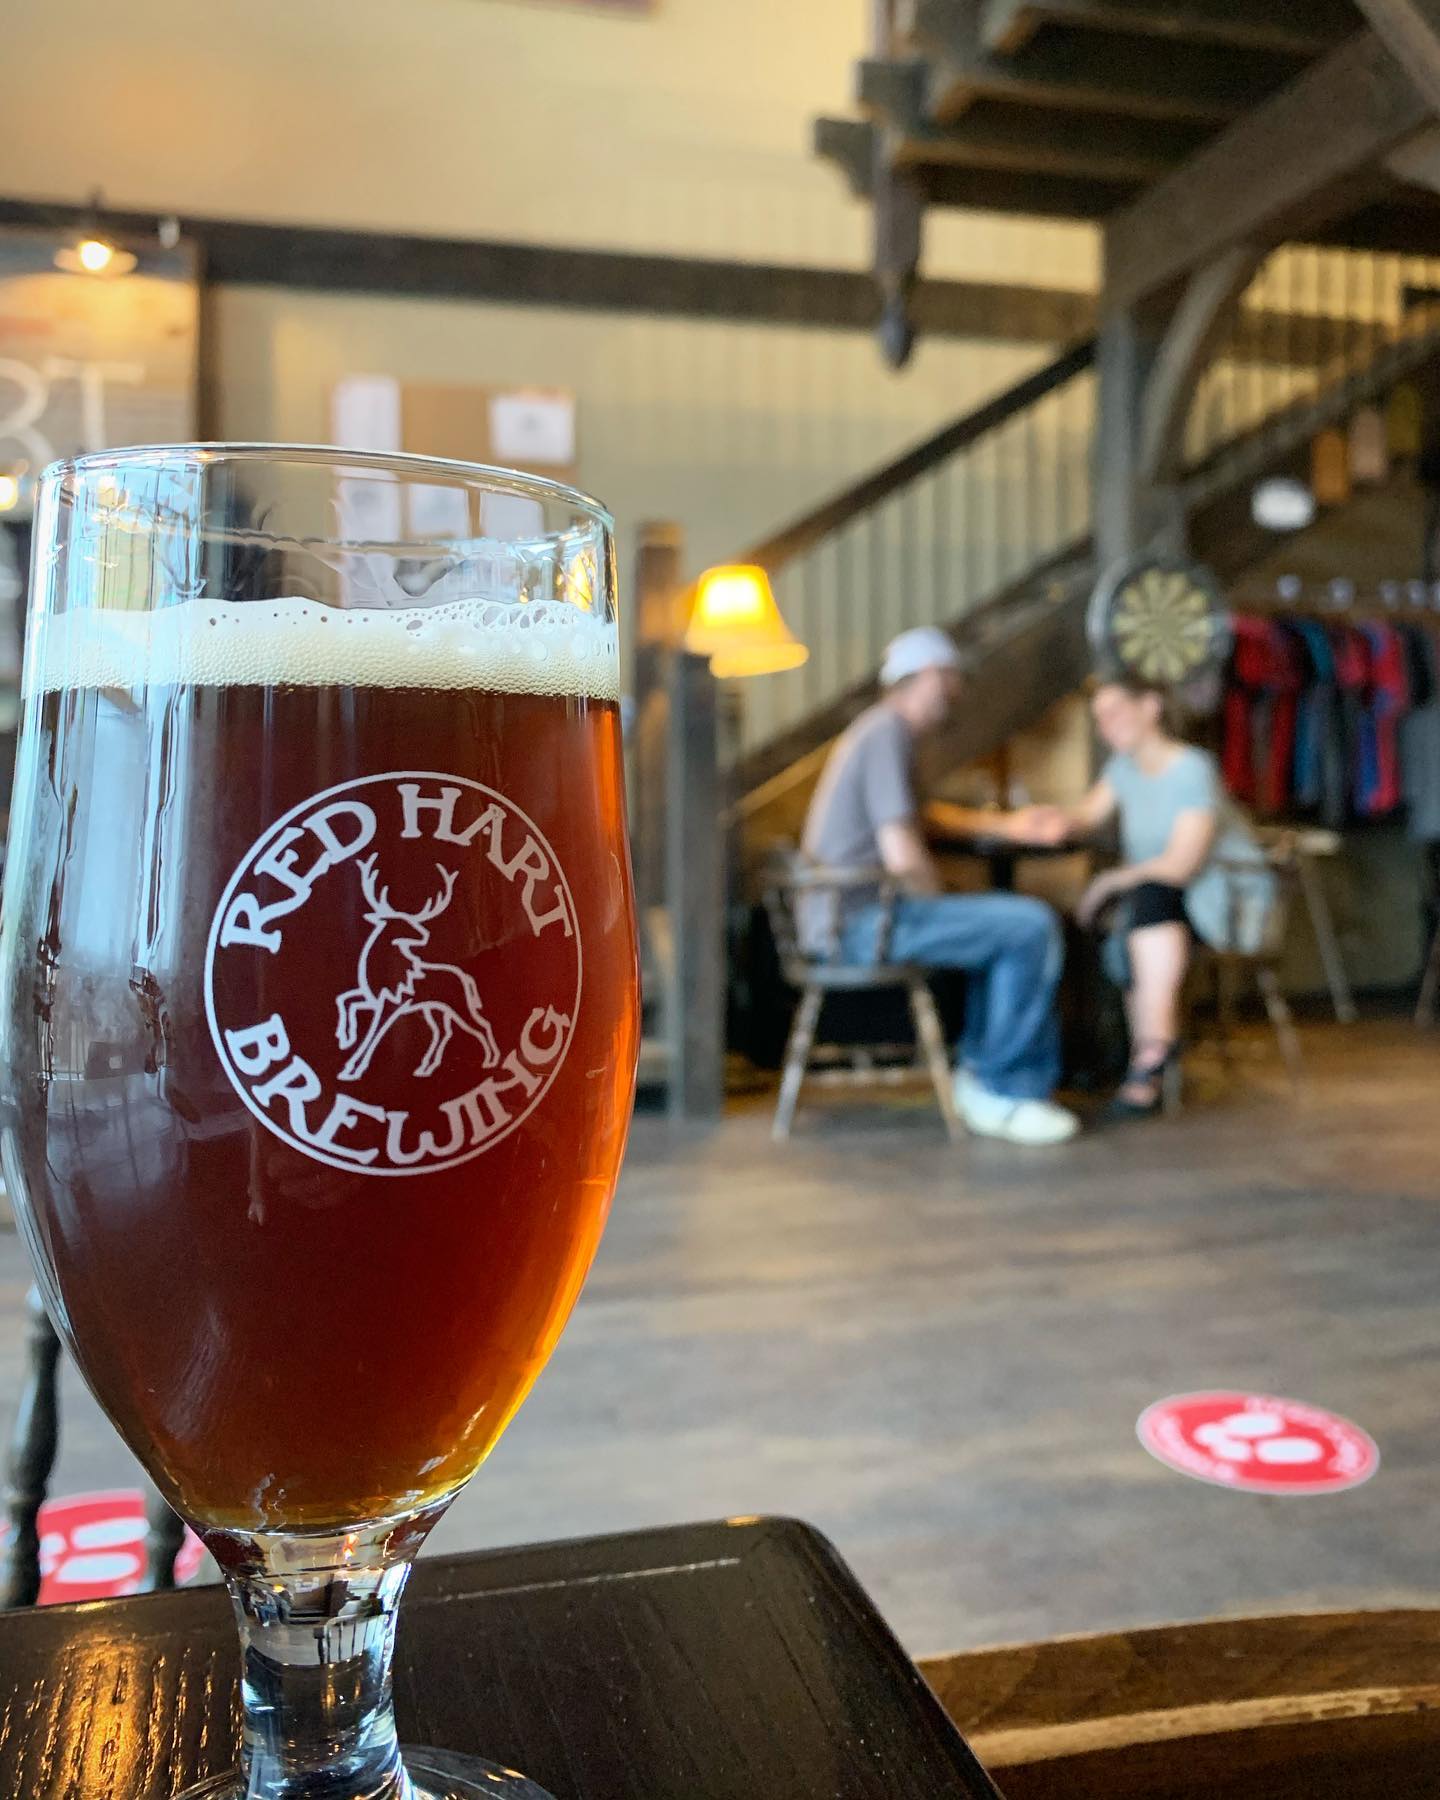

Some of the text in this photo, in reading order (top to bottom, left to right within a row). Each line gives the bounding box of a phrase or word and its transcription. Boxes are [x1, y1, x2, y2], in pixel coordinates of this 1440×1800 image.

[220, 783, 574, 954] RED HART
[225, 1004, 571, 1166] BREWING
